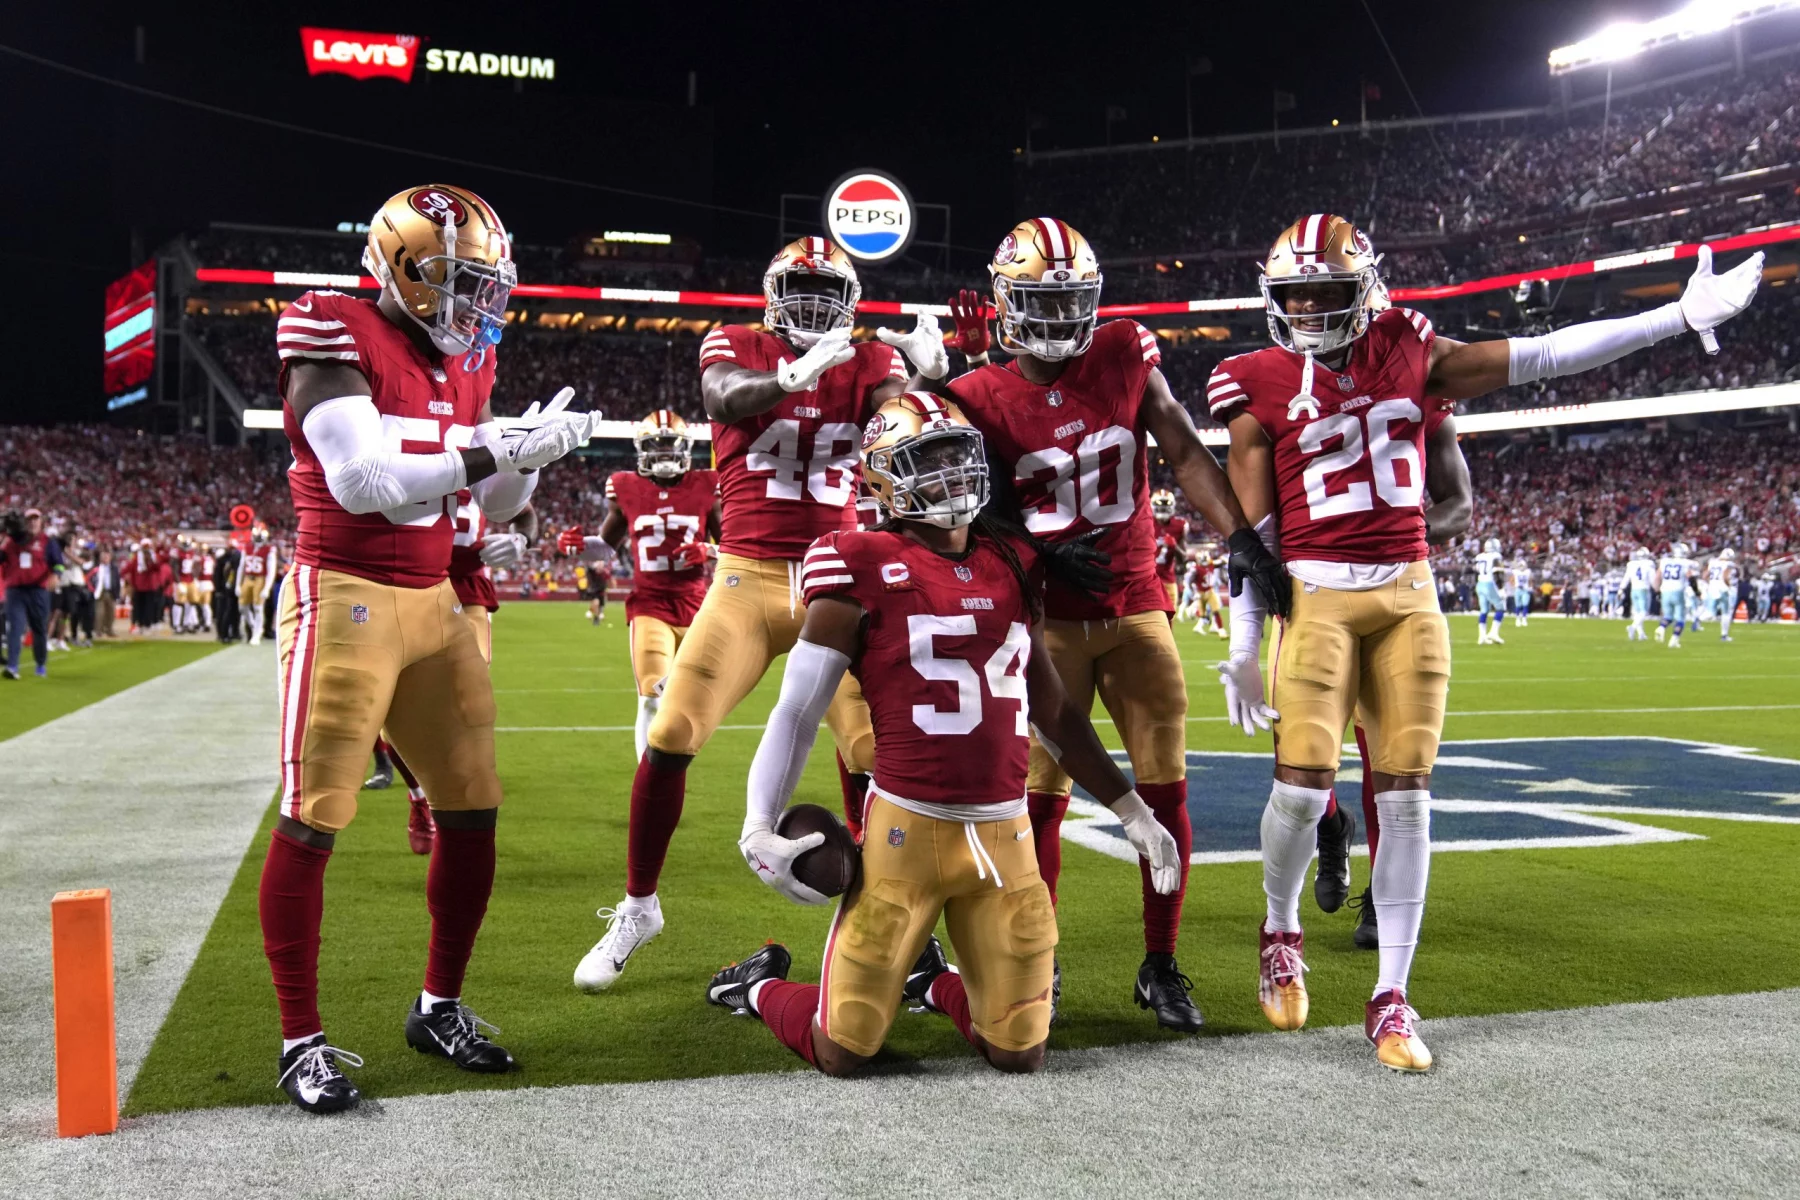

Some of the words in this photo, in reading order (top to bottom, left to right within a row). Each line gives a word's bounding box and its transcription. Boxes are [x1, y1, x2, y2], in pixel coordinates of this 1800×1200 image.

[426, 49, 555, 80] STADIUM
[836, 207, 903, 226] PEPSI
[793, 405, 821, 418] 49ERS
[1053, 419, 1087, 440] 49ERS
[746, 418, 862, 507] 48
[1297, 397, 1424, 521] 26
[1015, 424, 1137, 533] 30
[634, 514, 700, 572] 27
[881, 562, 910, 584] C
[1635, 566, 1643, 581] 4
[1664, 563, 1682, 581] 63
[960, 597, 994, 610] 49ERS
[906, 613, 1032, 737] 54
